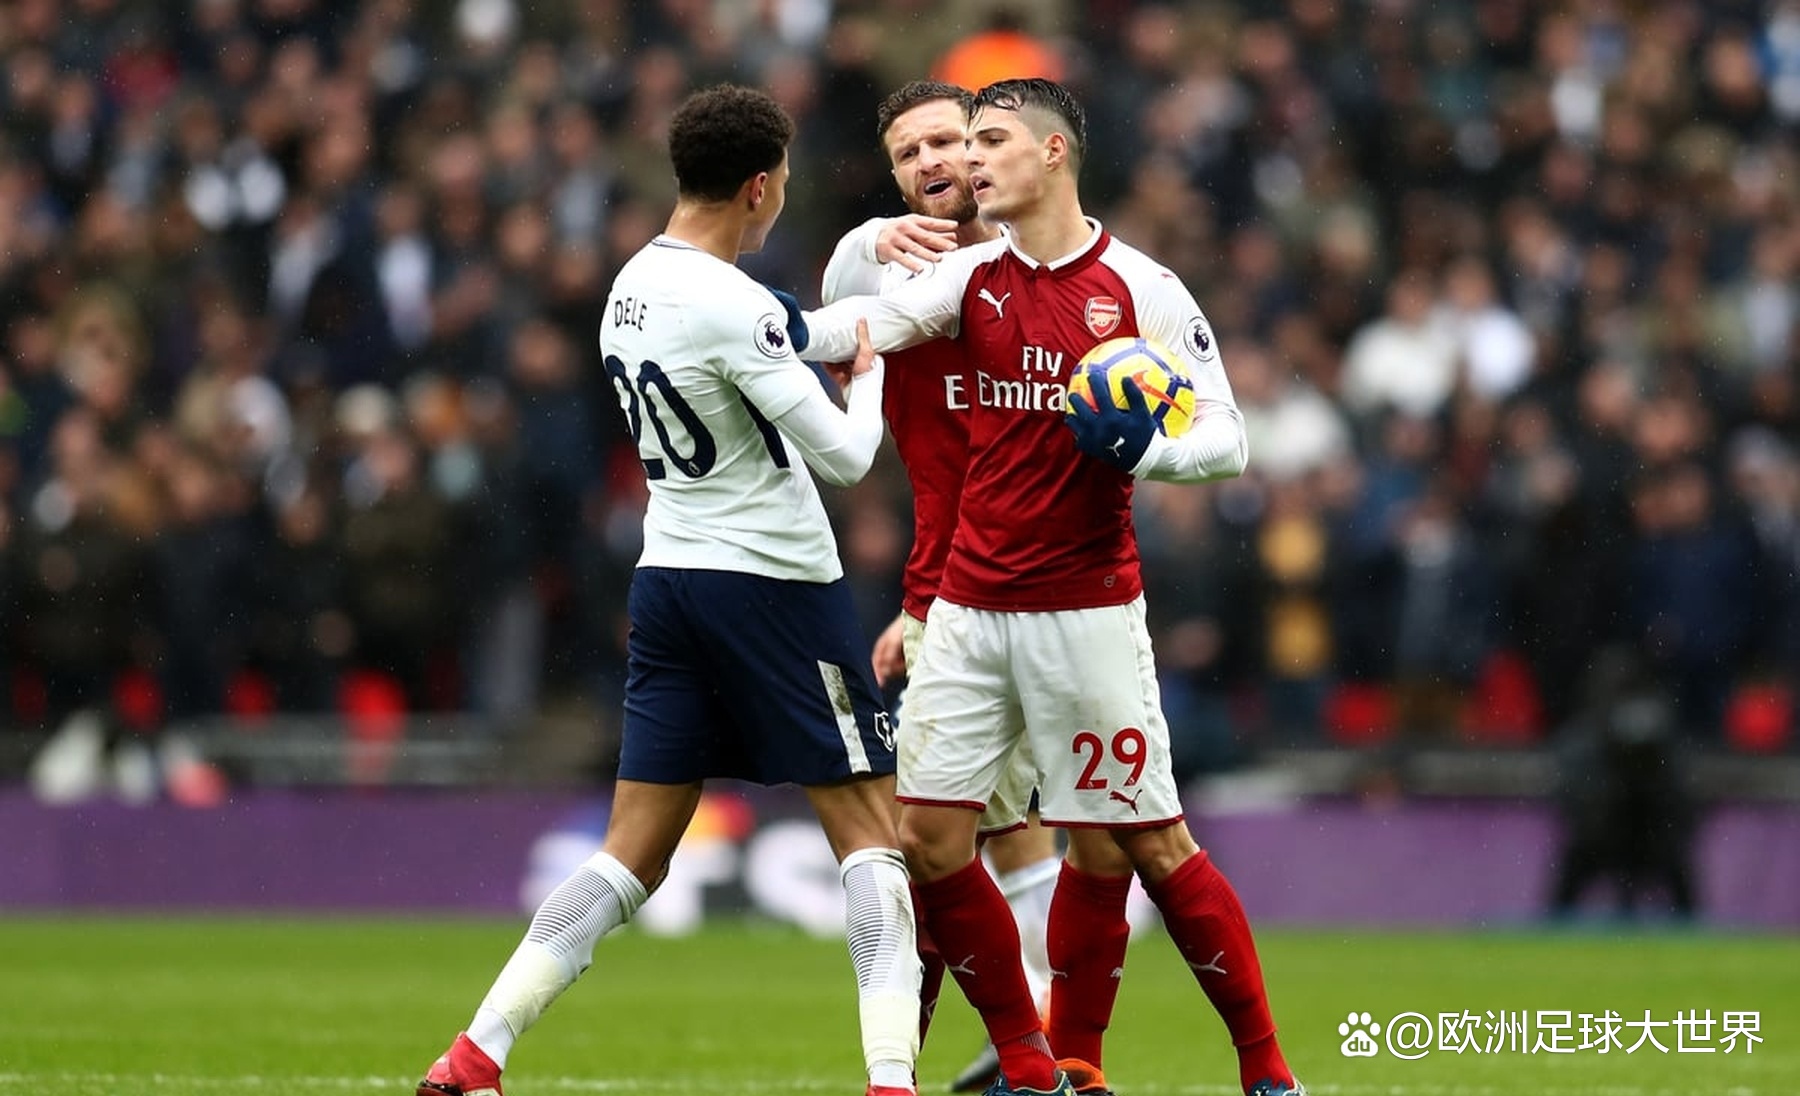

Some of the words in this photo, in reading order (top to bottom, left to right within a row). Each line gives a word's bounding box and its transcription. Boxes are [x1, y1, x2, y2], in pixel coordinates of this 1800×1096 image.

[614, 297, 648, 332] DELE
[1022, 345, 1063, 378] Fly
[604, 354, 717, 480] 20
[1071, 727, 1147, 790] 29
